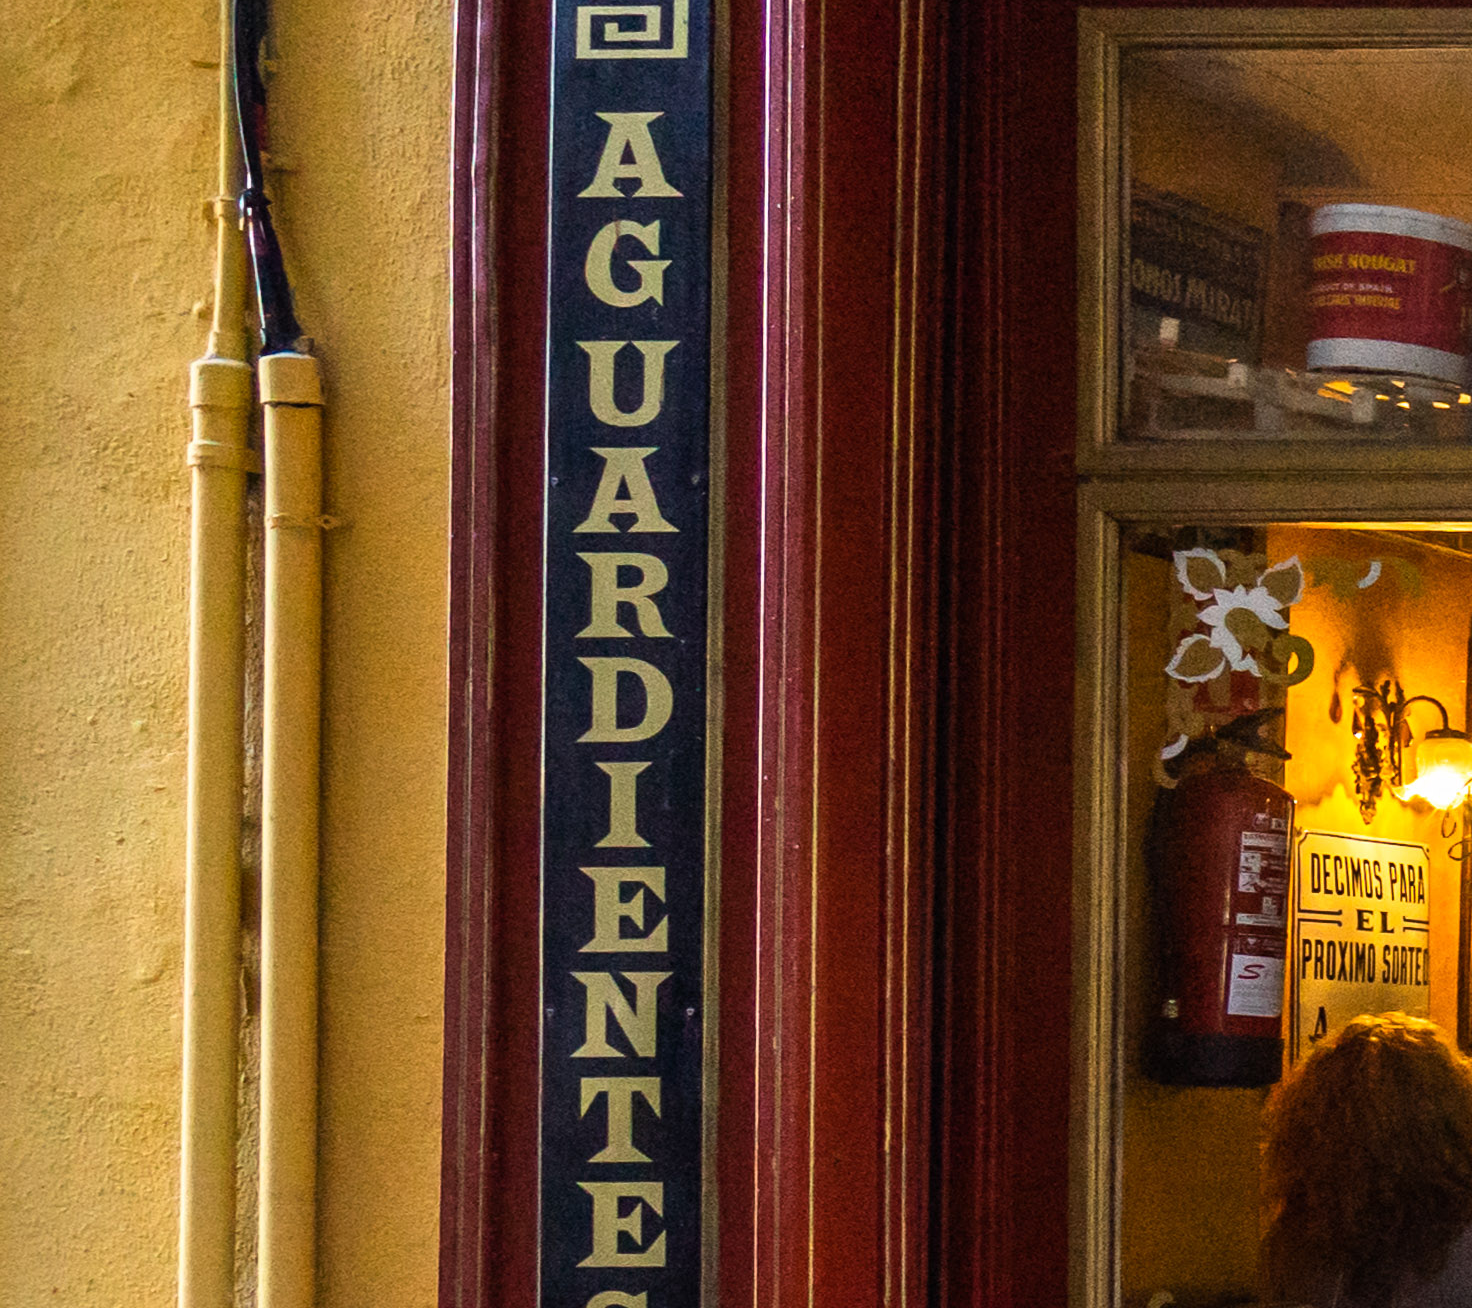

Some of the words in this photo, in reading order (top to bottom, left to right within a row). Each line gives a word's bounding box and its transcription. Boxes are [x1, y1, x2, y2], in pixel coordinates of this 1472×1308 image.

[1310, 851, 1383, 902] DECIMOS
[1388, 861, 1426, 905] PARA
[1356, 908, 1396, 935] EL
[1301, 938, 1376, 985] PROXIMO
